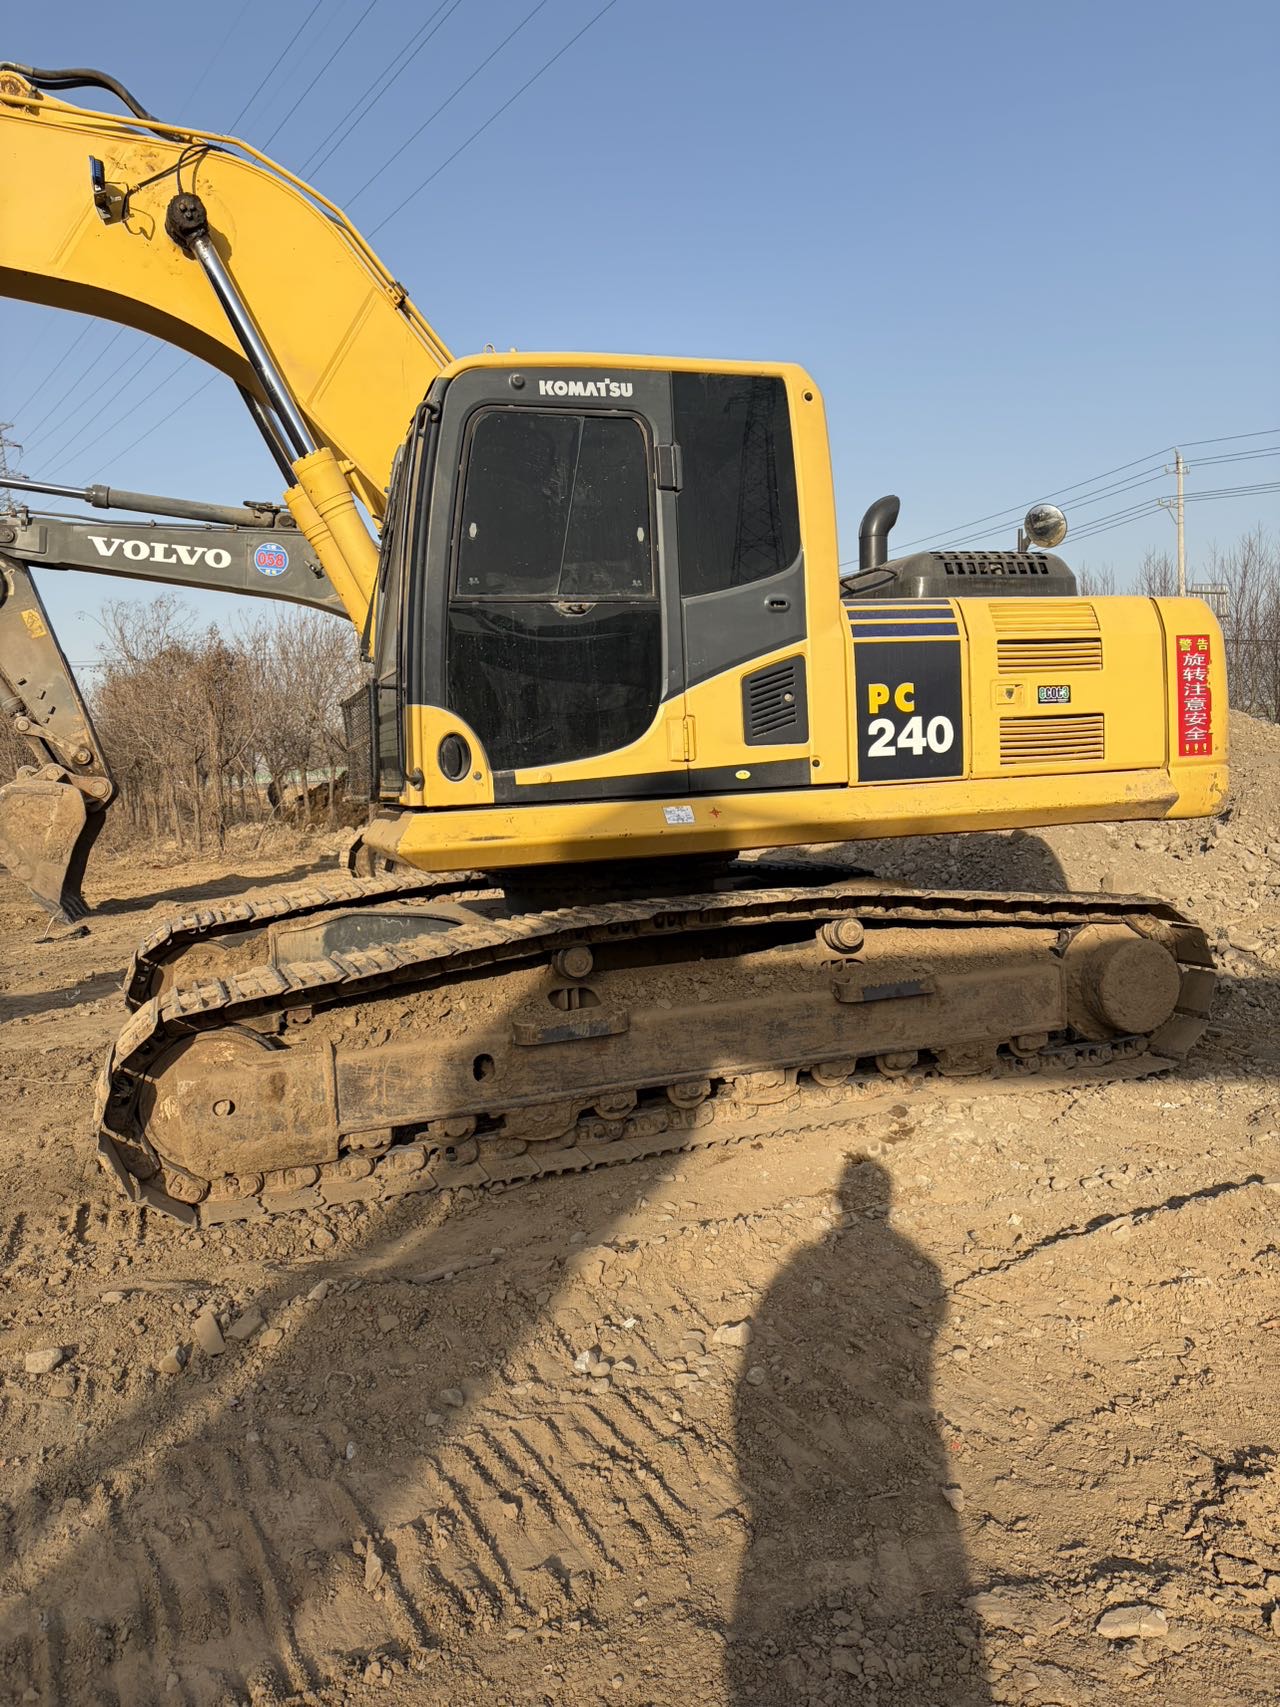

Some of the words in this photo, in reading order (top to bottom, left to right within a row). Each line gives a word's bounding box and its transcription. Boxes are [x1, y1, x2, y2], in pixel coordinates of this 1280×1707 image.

[539, 378, 633, 397] KOMATSU
[87, 535, 232, 568] VOLVO
[257, 551, 285, 568] 058
[1179, 638, 1208, 651] 警告
[868, 682, 914, 714] PC
[868, 715, 954, 757] 240
